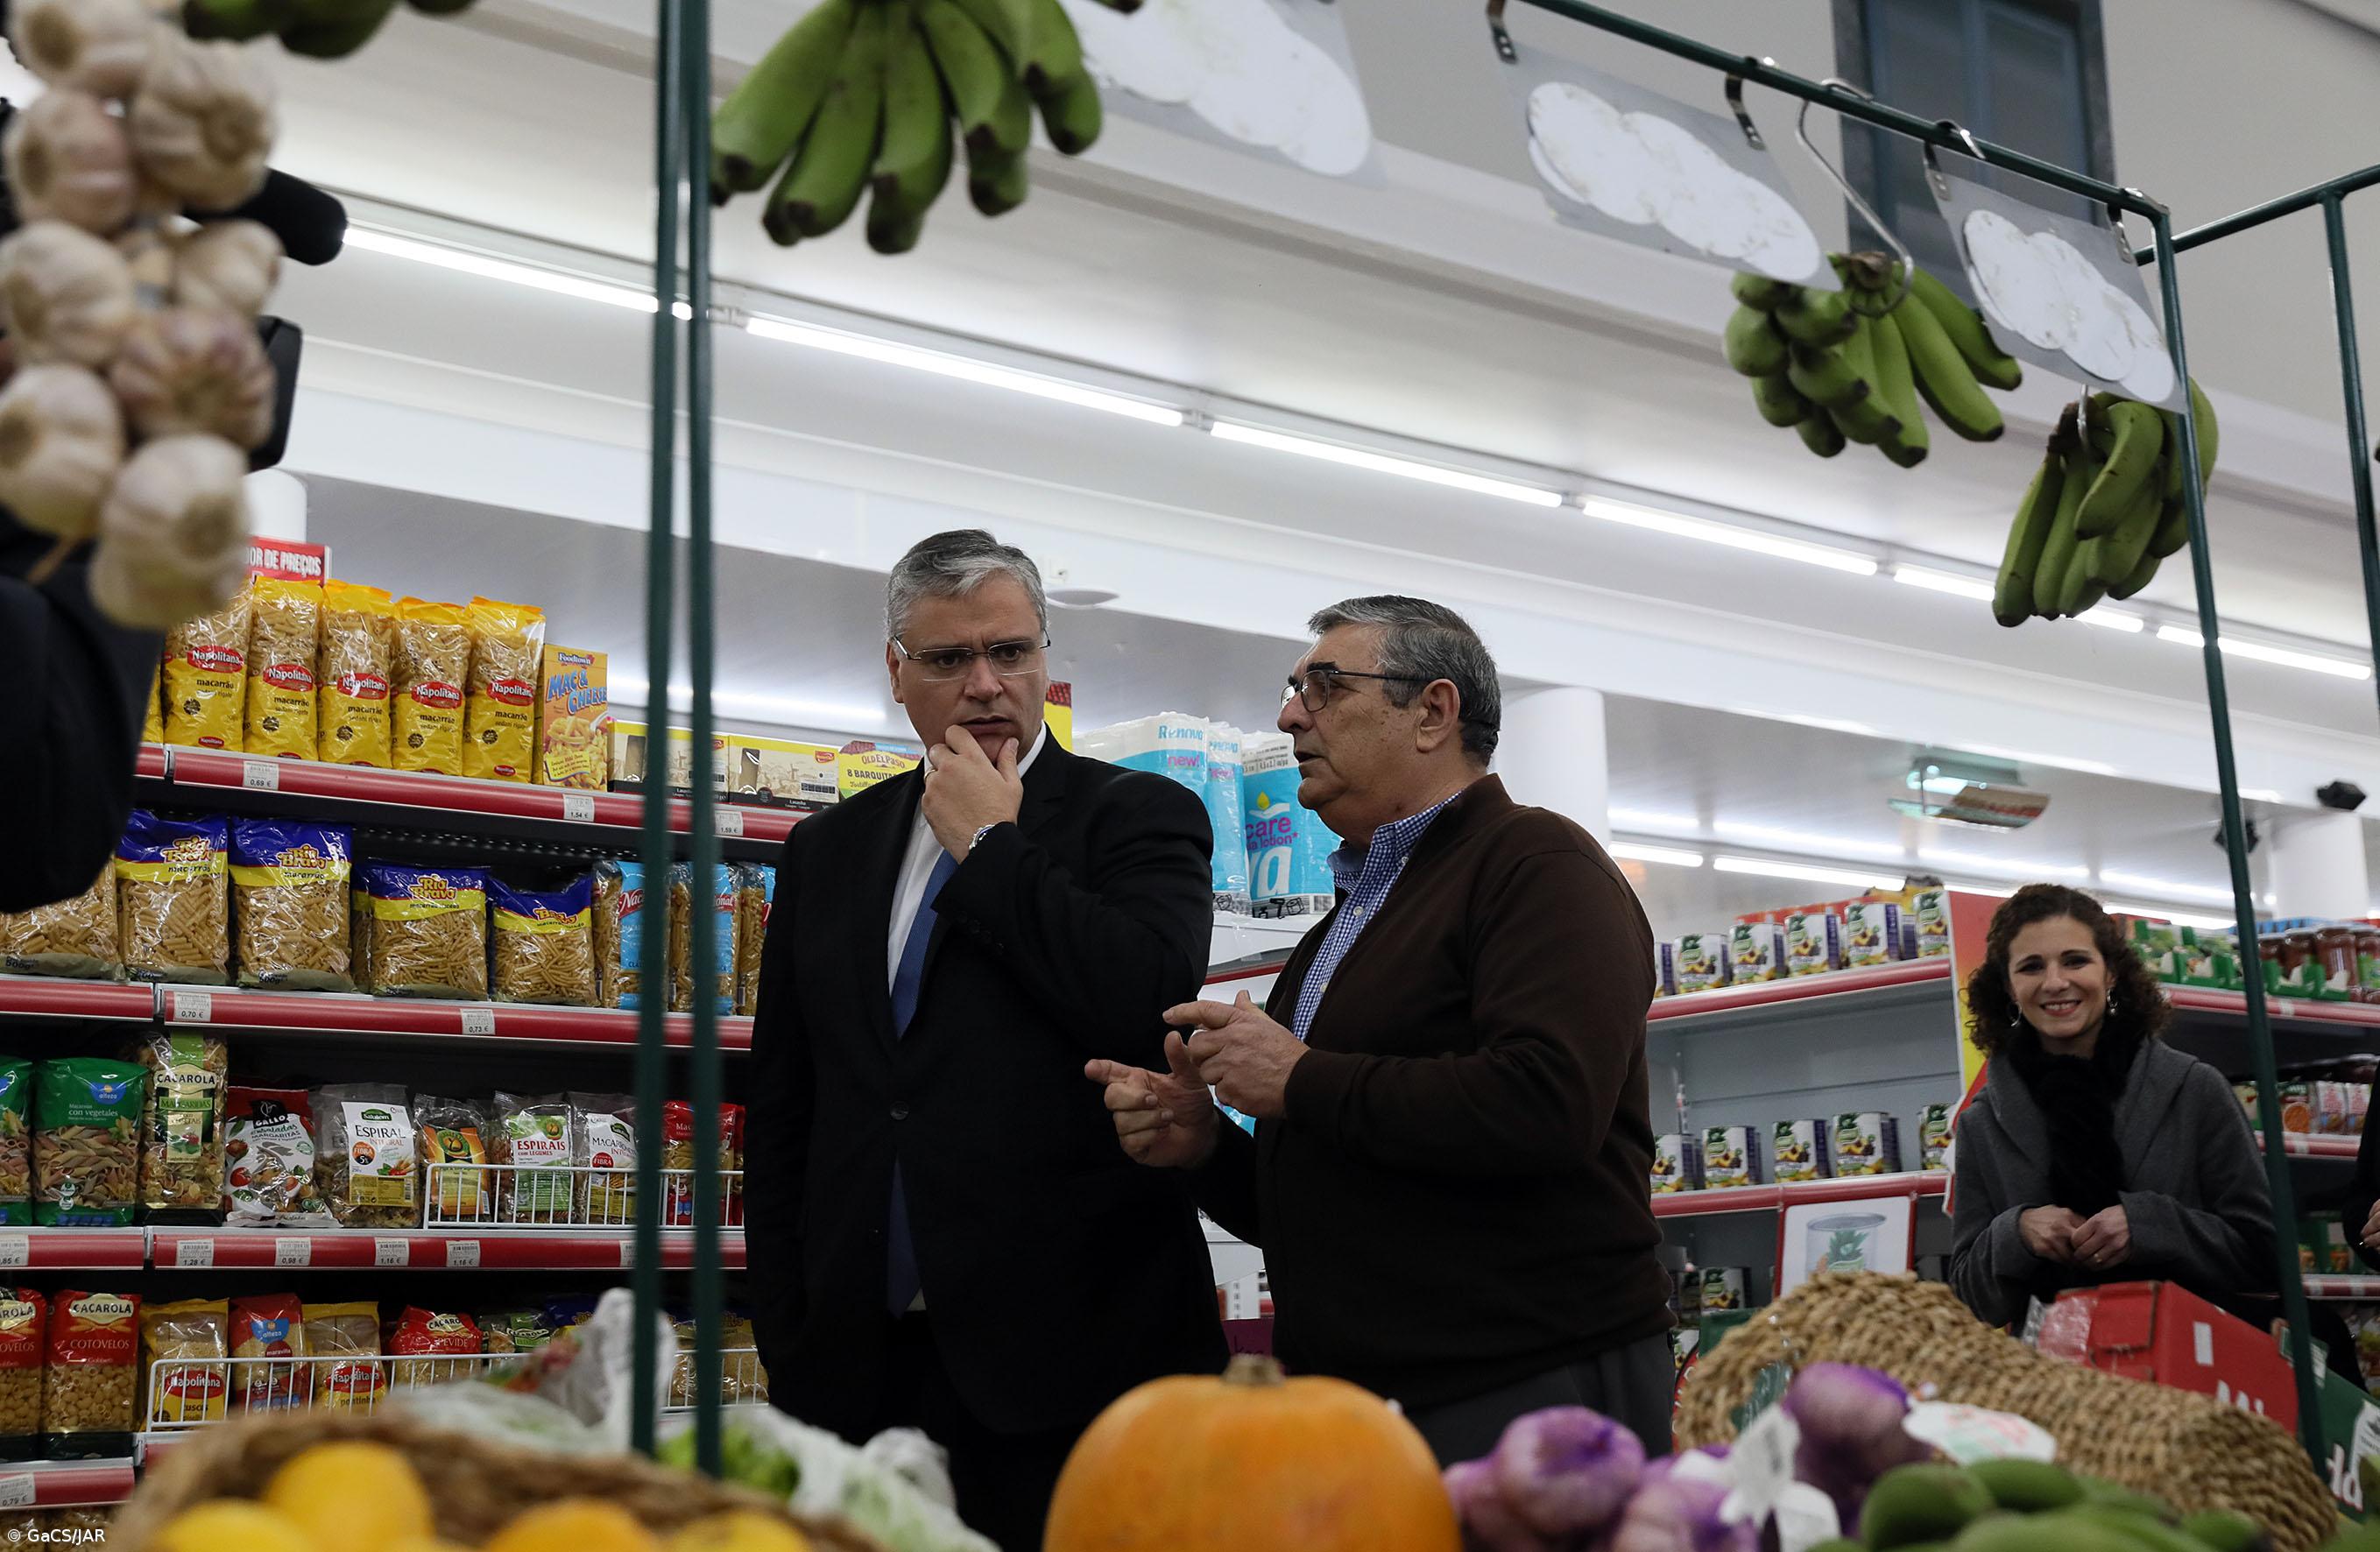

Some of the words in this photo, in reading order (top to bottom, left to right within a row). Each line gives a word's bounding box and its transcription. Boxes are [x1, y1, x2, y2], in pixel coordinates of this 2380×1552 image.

[265, 549, 279, 569] DE
[280, 552, 321, 577] PREÇOS
[192, 650, 241, 665] Napolitana
[269, 668, 312, 682] Napolitana
[196, 679, 234, 688] macarrão
[343, 678, 386, 691] Napolitana
[491, 682, 533, 698] Napolitana
[547, 672, 578, 702] MAC
[578, 668, 588, 689] &
[416, 686, 461, 701] Napolitana
[568, 686, 608, 715] CHEESE
[1158, 725, 1203, 740] Renova
[862, 754, 876, 765] OLD
[1168, 754, 1200, 769] new!
[847, 768, 852, 777] 8
[854, 769, 896, 780] BARQUITA
[1245, 816, 1292, 840] care
[419, 874, 447, 890] Rio
[410, 885, 456, 899] Bravo
[715, 896, 735, 907] onal
[181, 1010, 196, 1019] 0,70
[255, 1115, 286, 1126] GALLO
[355, 1125, 406, 1139] ESPIRAL
[517, 1139, 566, 1151] ESPIRAIS
[0, 1341, 35, 1353] OVELOS
[70, 1338, 131, 1350] COTOVELOS
